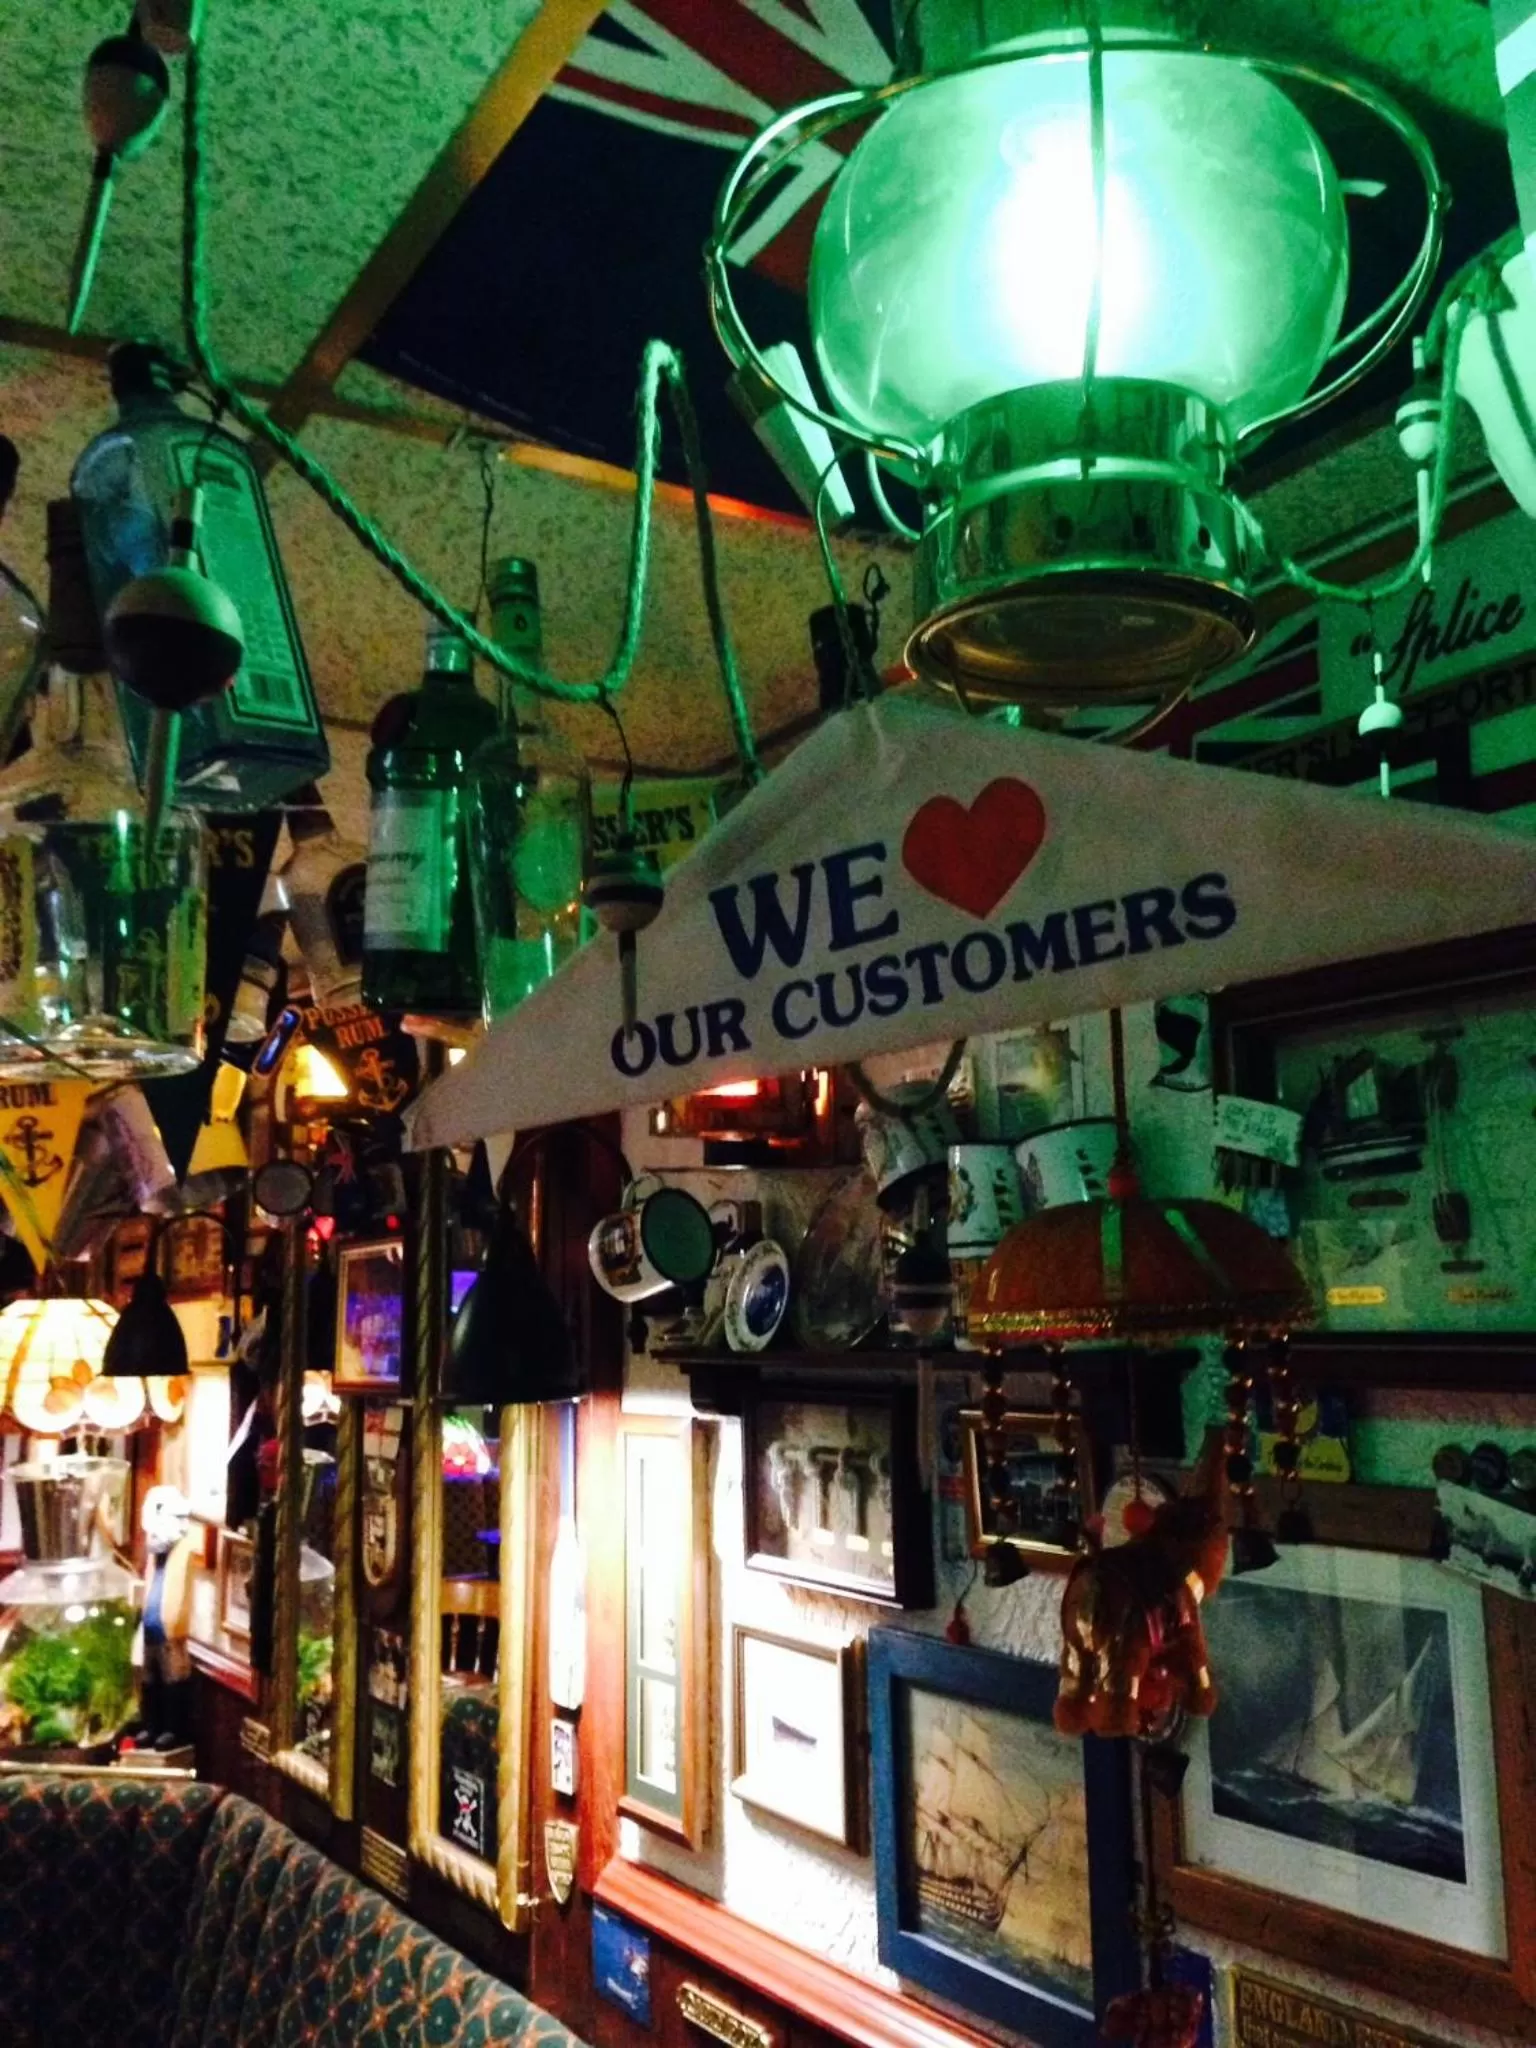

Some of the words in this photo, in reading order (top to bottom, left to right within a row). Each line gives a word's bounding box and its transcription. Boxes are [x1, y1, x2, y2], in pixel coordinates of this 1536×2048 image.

[611, 997, 752, 1078] OUR
[771, 872, 1237, 1040] CUSTOMERS
[708, 842, 899, 979] WE
[336, 1016, 387, 1049] RUM
